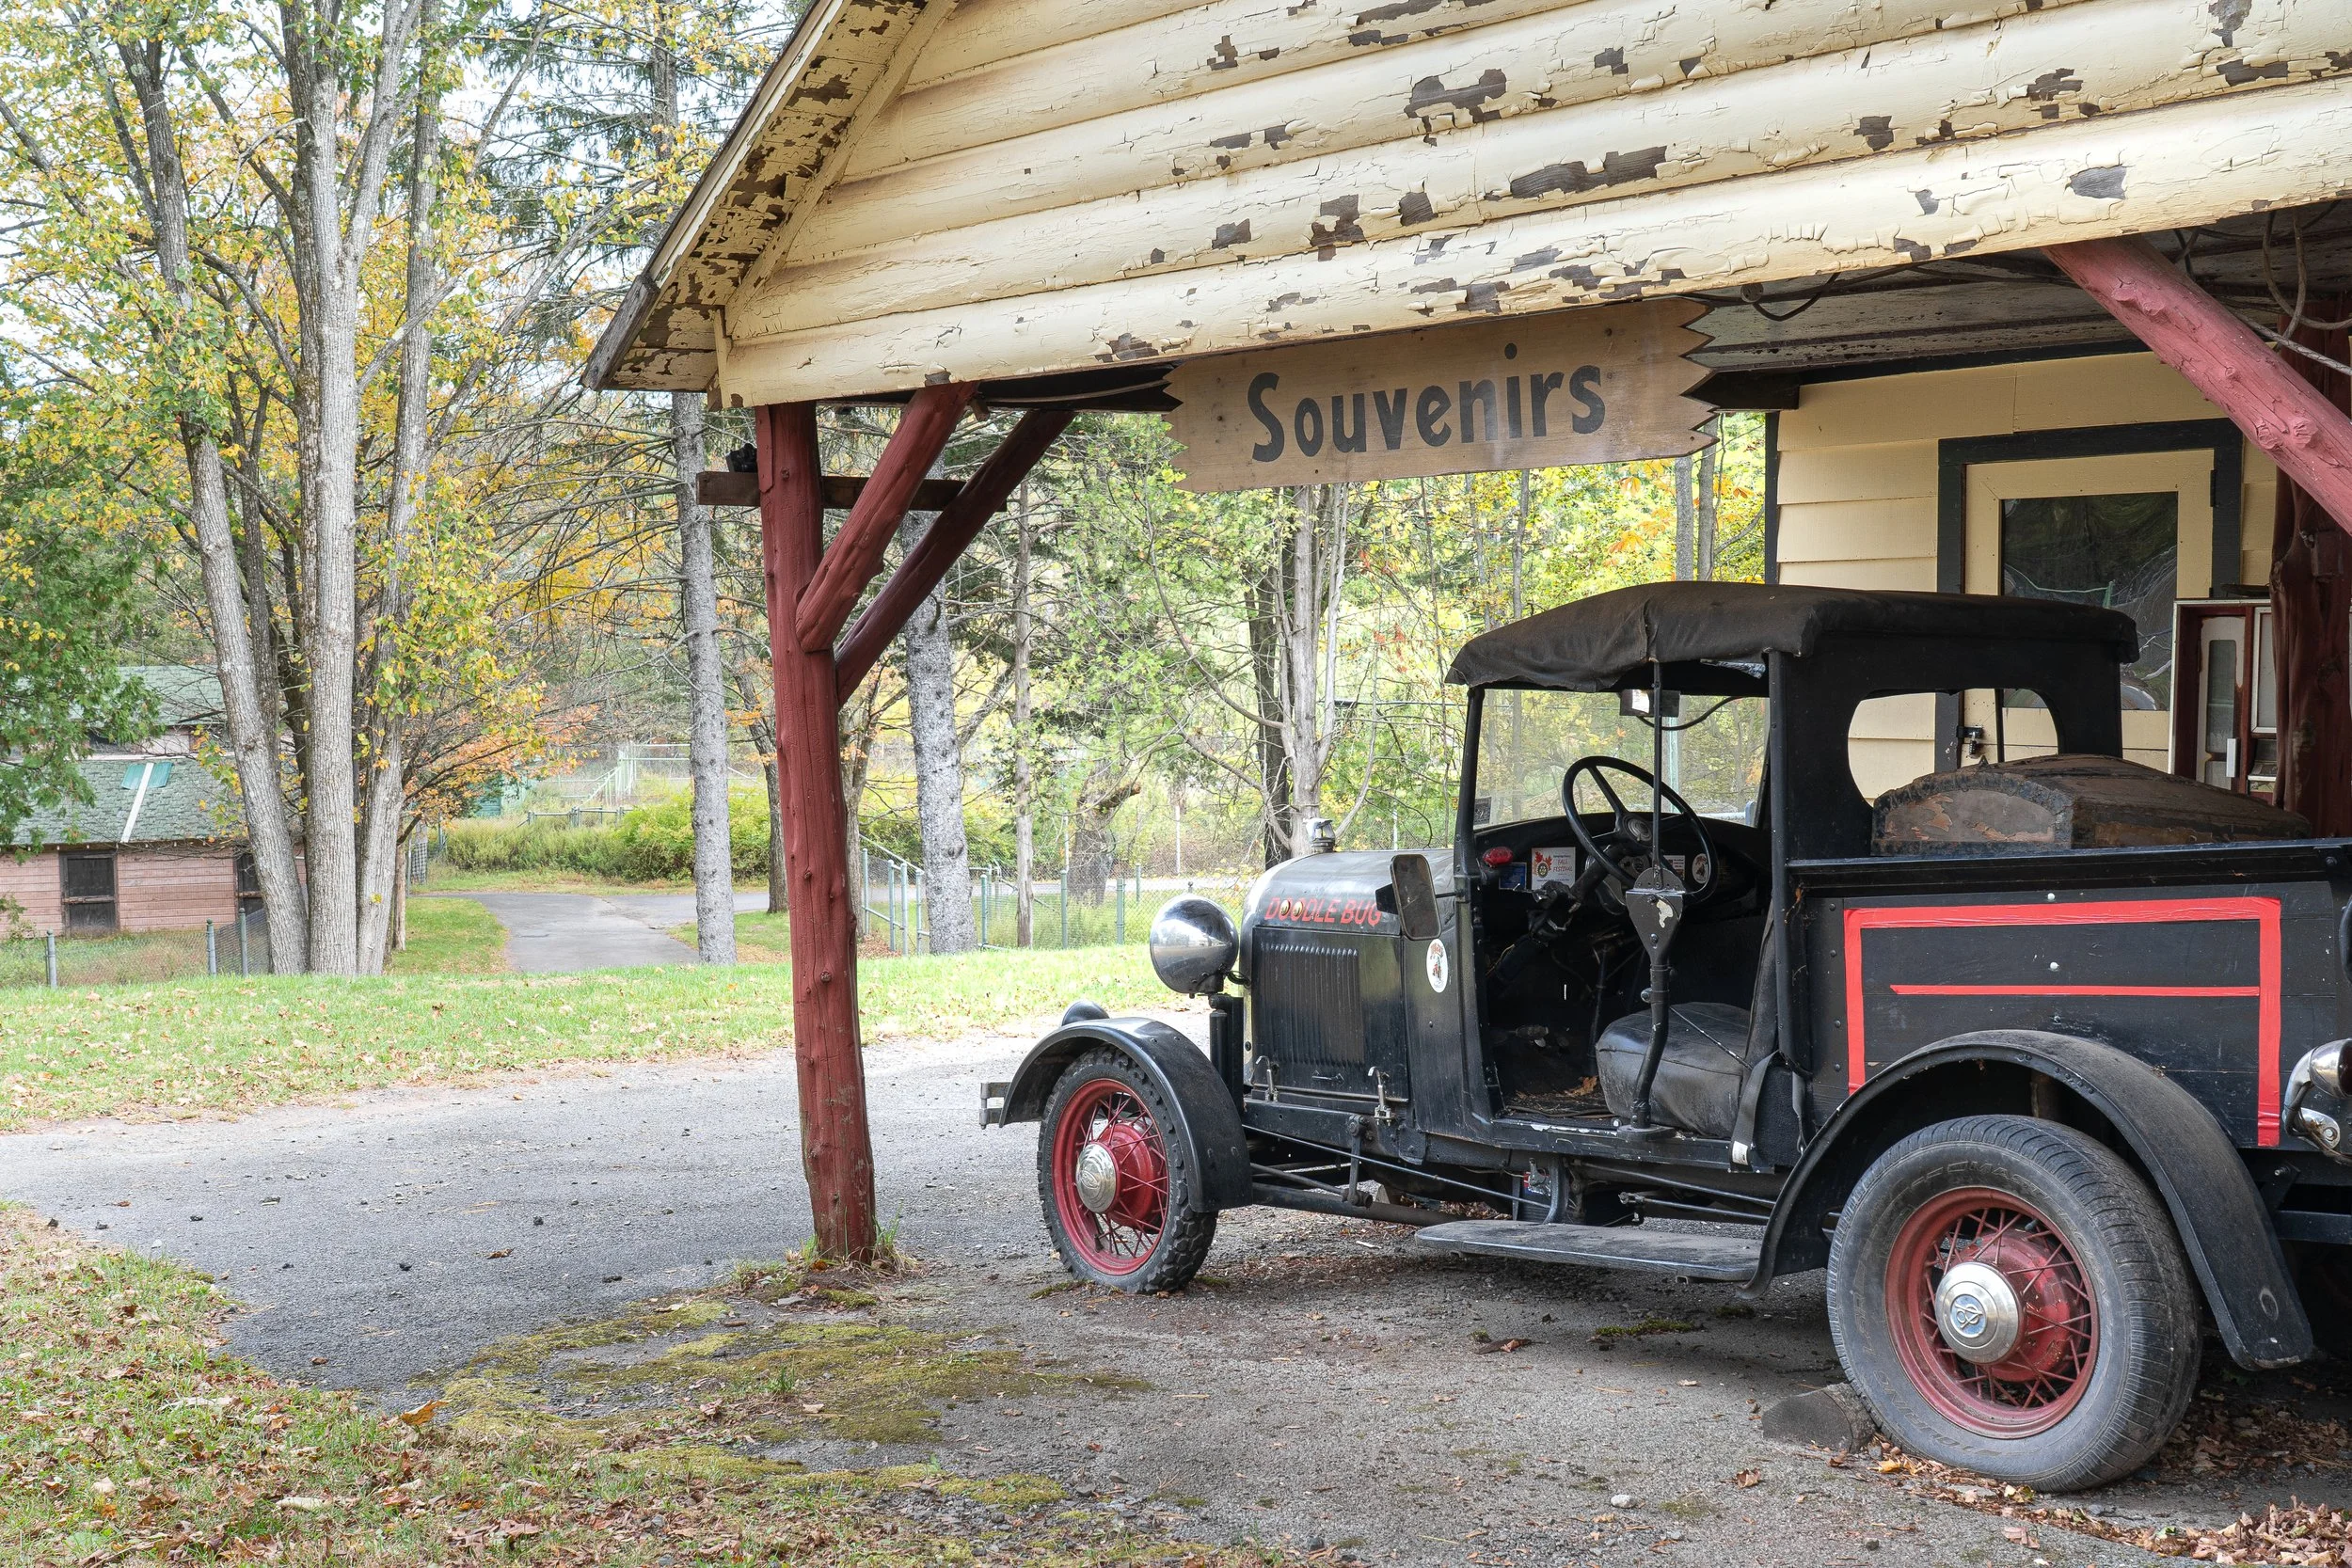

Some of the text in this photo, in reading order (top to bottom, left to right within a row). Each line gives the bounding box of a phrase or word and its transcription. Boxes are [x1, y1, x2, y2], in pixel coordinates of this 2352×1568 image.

[1248, 342, 1606, 462] Souvenirs
[1264, 896, 1383, 926] DOODLE BUG
